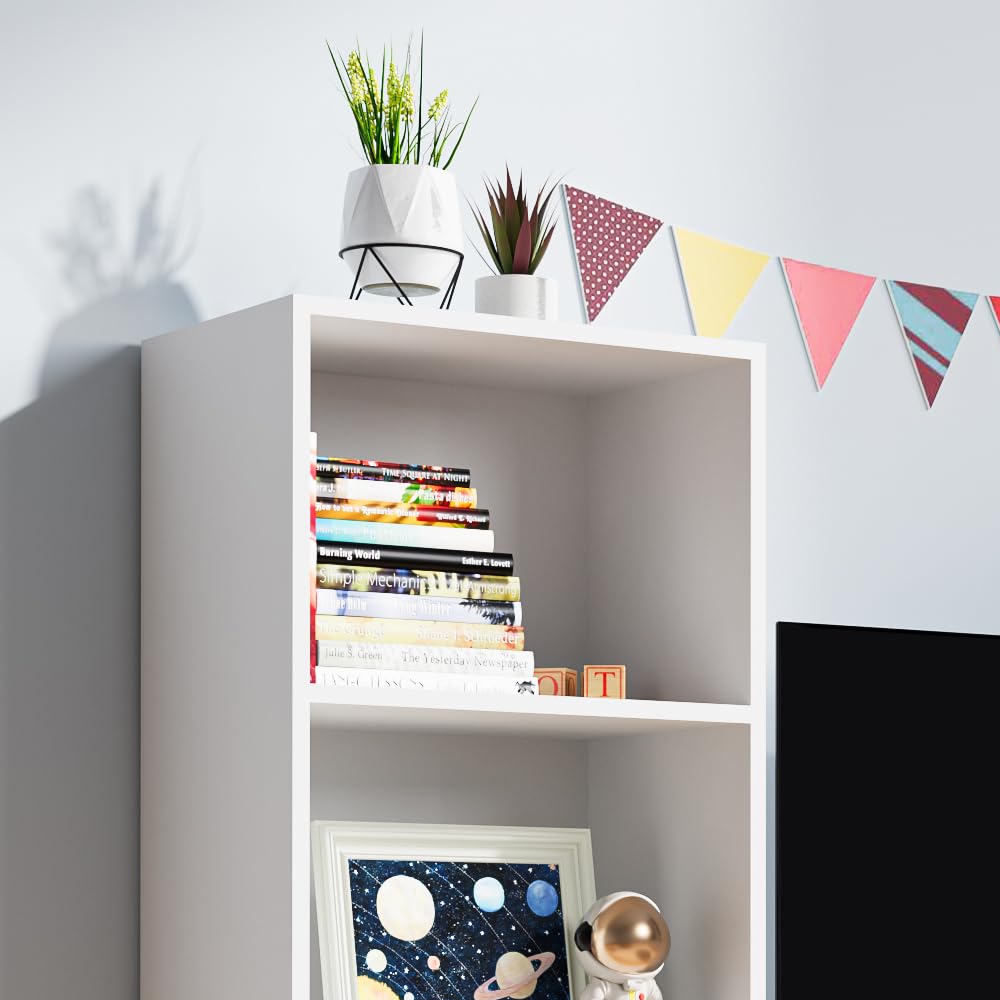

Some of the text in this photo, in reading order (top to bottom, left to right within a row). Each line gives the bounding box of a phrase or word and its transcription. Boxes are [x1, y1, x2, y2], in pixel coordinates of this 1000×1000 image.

[382, 467, 469, 482] TIME SQUARE AT NIGHT
[320, 546, 380, 560] Burning World
[462, 557, 482, 566] Esther
[491, 558, 511, 568] Lovett
[319, 568, 361, 587] Simple
[357, 648, 383, 660] Green
[400, 651, 420, 664] The
[474, 656, 529, 671] Newspaper
[594, 672, 615, 697] T
